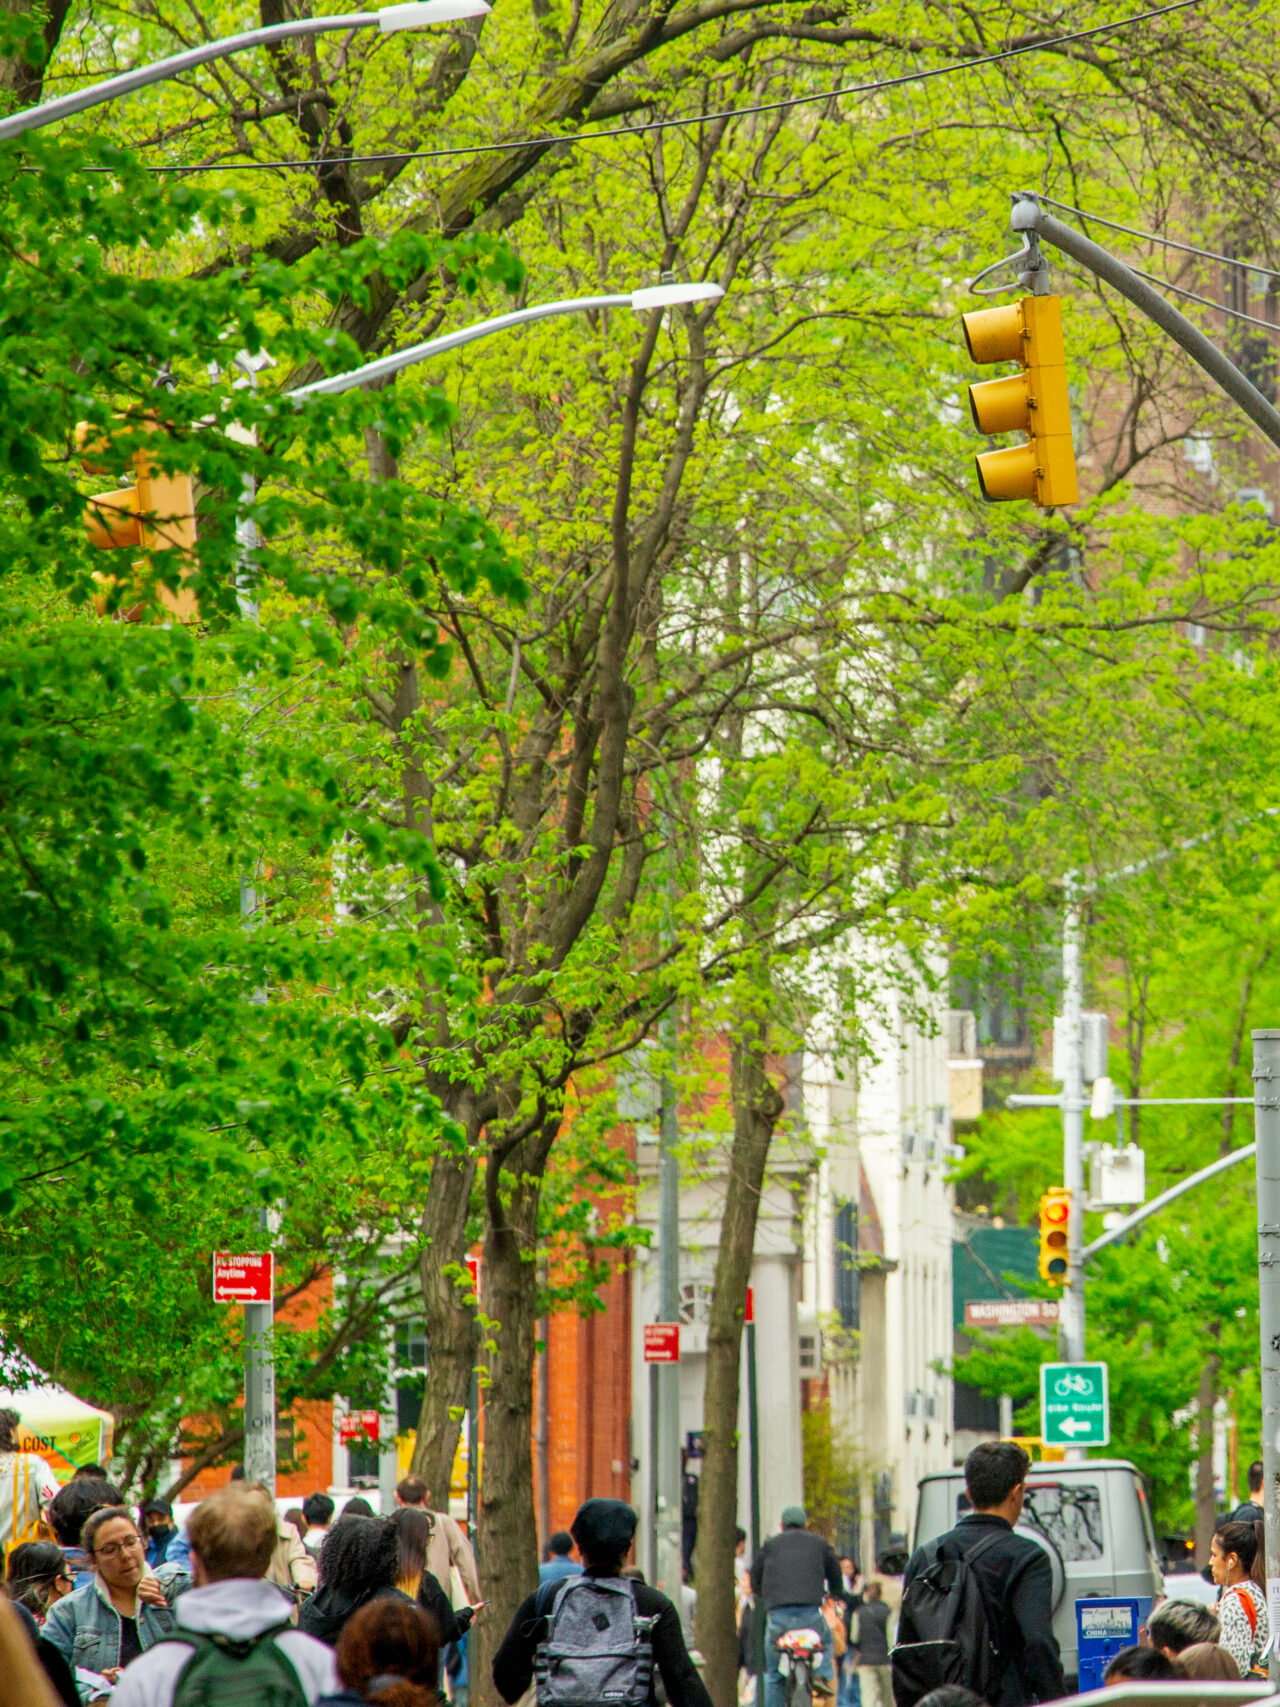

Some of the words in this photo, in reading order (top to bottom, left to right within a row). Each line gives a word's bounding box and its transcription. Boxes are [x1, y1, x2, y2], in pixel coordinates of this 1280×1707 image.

[229, 1256, 263, 1267] STOPPING
[217, 1268, 246, 1280] Anytime
[23, 1435, 57, 1452] COST
